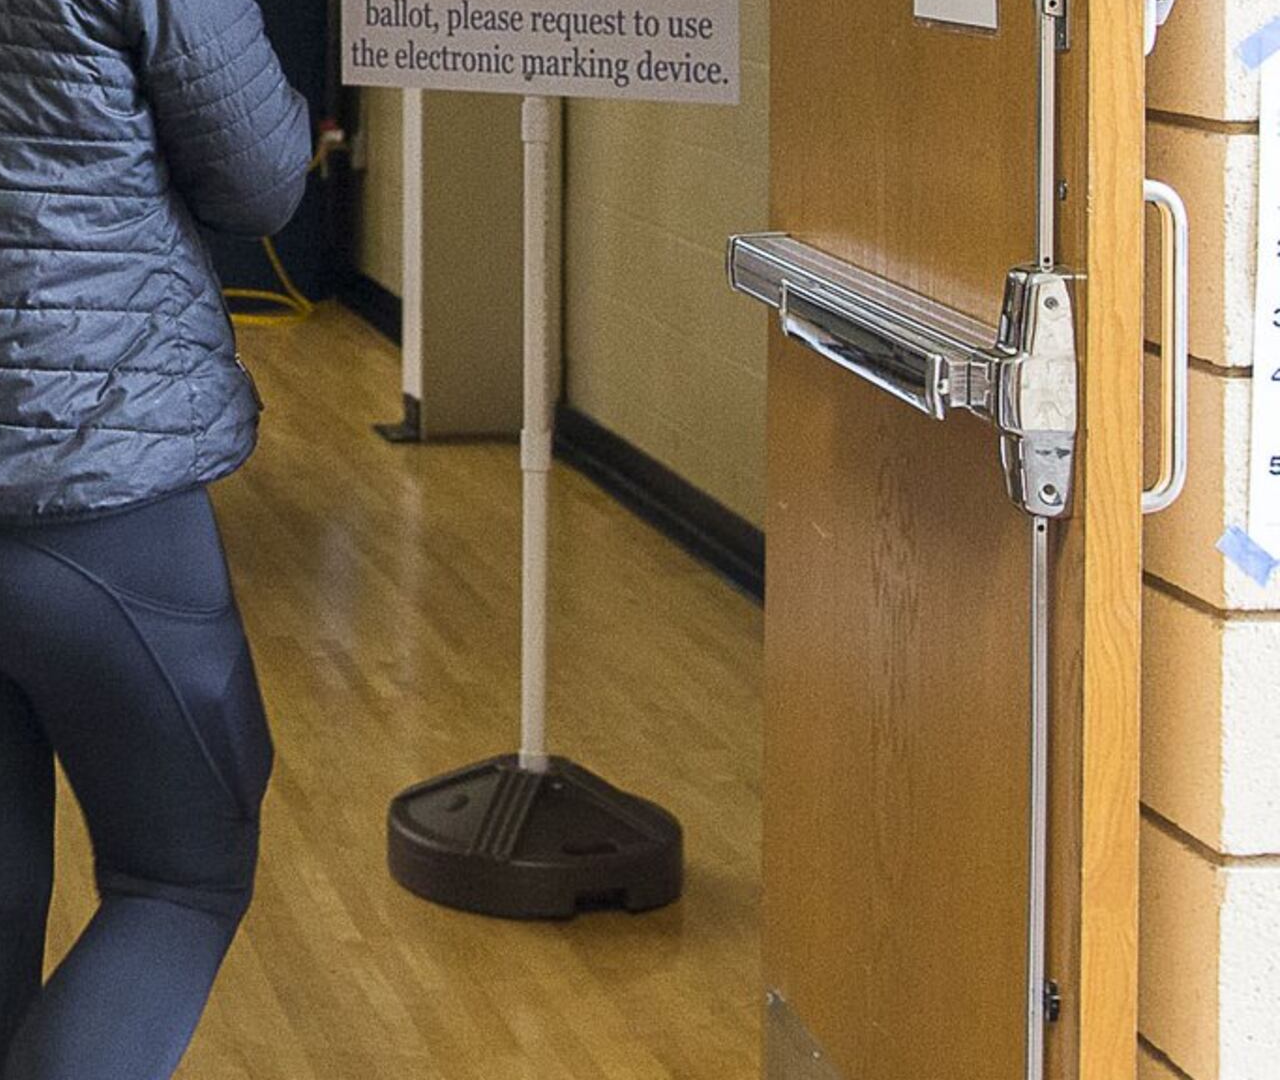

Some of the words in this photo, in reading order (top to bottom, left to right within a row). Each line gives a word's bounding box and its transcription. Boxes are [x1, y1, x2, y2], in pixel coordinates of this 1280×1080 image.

[447, 0, 523, 36] please
[531, 11, 626, 41] request
[633, 11, 660, 37] to
[668, 17, 713, 39] use
[351, 38, 388, 68] the
[395, 40, 514, 73] electronic
[522, 47, 630, 87] marking
[637, 50, 728, 84] device.
